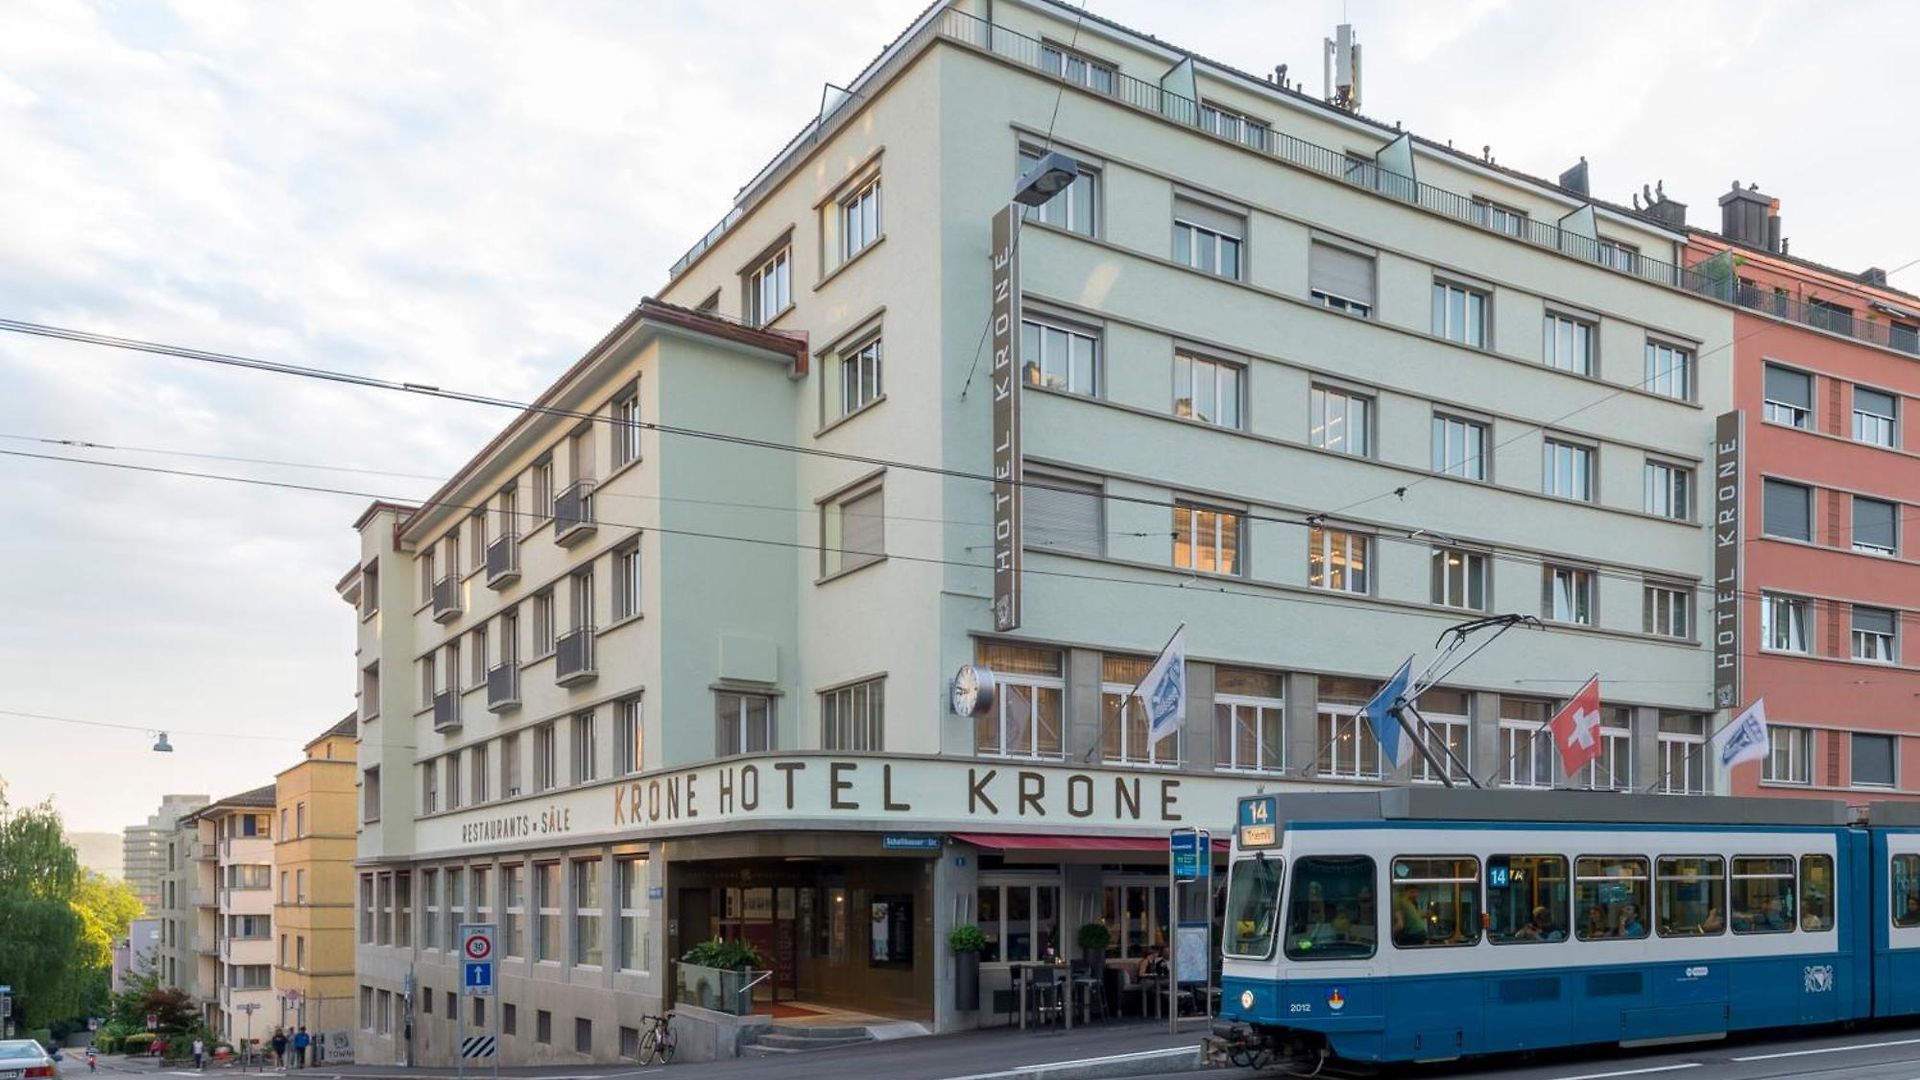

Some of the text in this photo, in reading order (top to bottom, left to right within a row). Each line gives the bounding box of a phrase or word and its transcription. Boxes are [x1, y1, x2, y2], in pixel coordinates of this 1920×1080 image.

[994, 246, 1011, 574] HOTEL KRONE
[1717, 438, 1736, 669] HOTEL KRONE
[613, 773, 698, 826] KRONE
[718, 761, 1182, 821] HOTEL KRONE
[462, 805, 570, 843] RESTAURANTS SÄLE
[1249, 800, 1268, 824] 14
[1490, 869, 1506, 884] 14
[472, 942, 484, 952] 30
[1290, 1003, 1312, 1012] 2012
